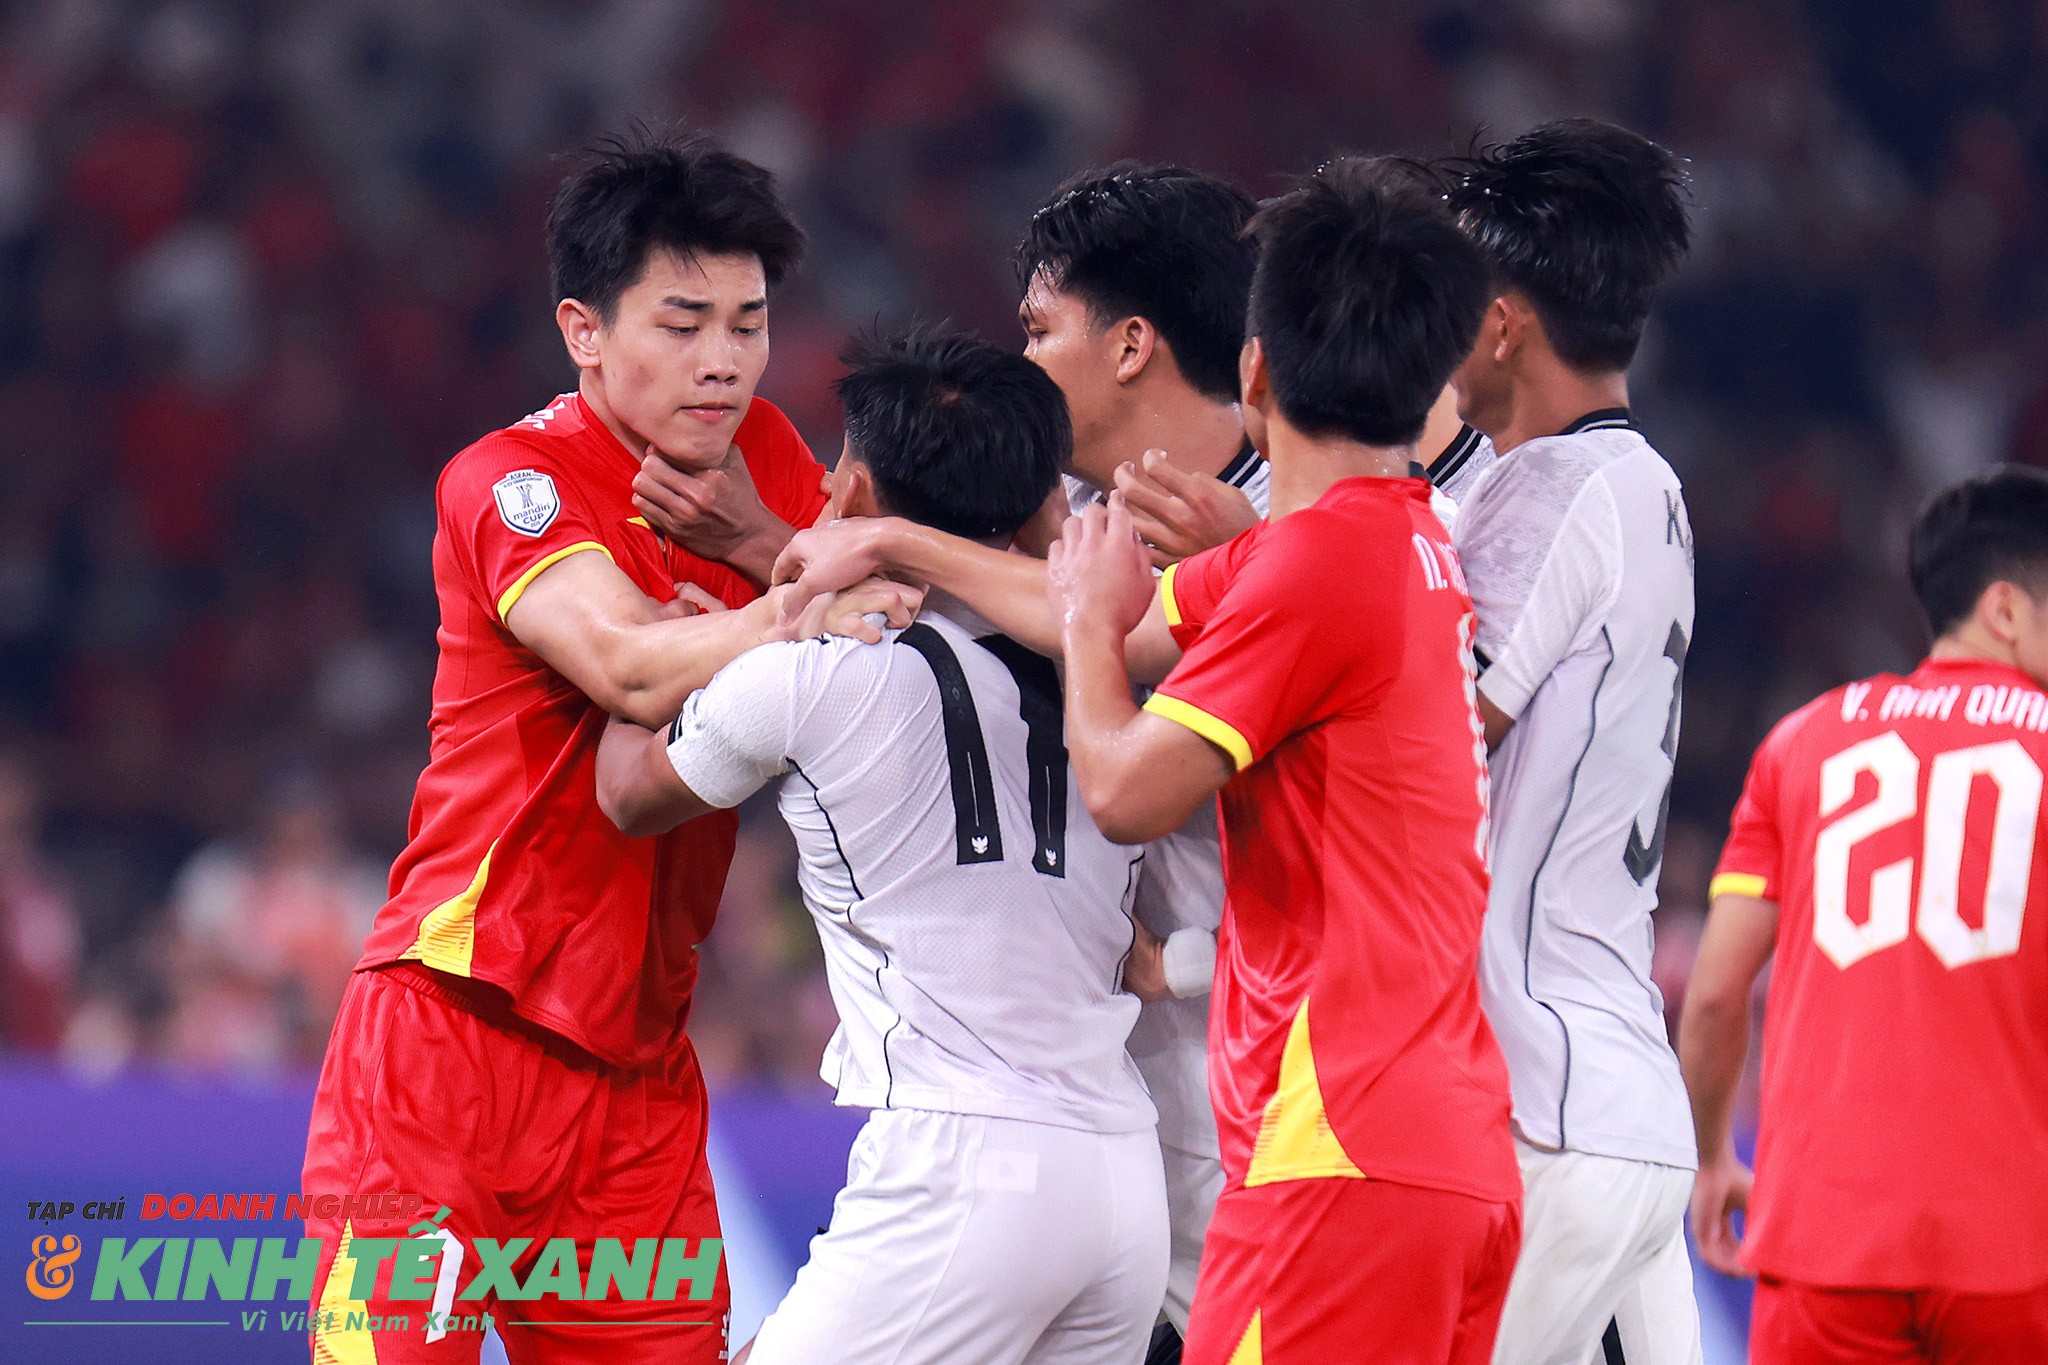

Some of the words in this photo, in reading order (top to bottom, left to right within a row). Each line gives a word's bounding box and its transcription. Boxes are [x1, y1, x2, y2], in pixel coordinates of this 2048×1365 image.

[513, 502, 551, 521] mandiri
[522, 512, 544, 525] CUP
[1841, 682, 1872, 723] V.
[1813, 729, 2044, 972] 20
